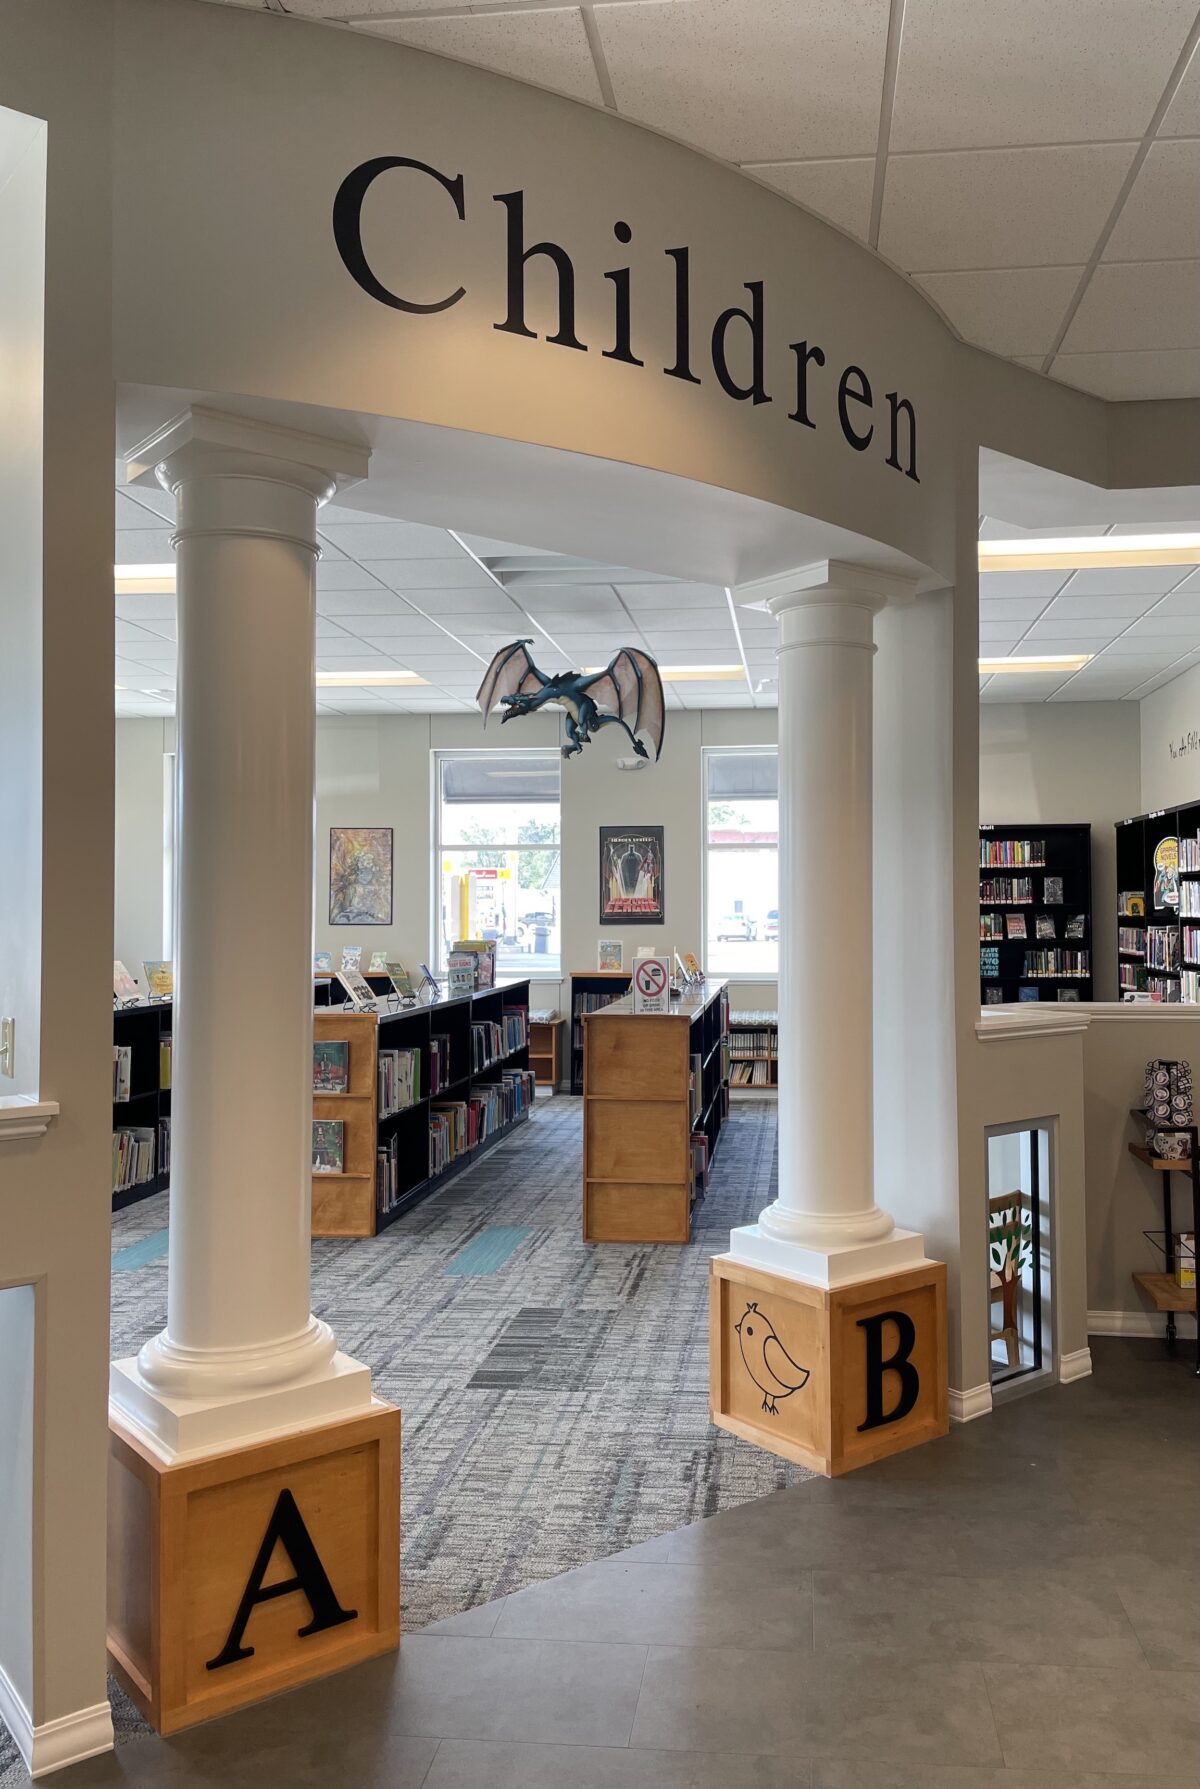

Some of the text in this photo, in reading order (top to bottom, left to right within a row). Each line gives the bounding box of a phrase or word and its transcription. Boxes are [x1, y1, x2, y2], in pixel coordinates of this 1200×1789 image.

[332, 155, 921, 484] Children
[856, 1310, 920, 1433] B
[205, 1488, 358, 1670] A
